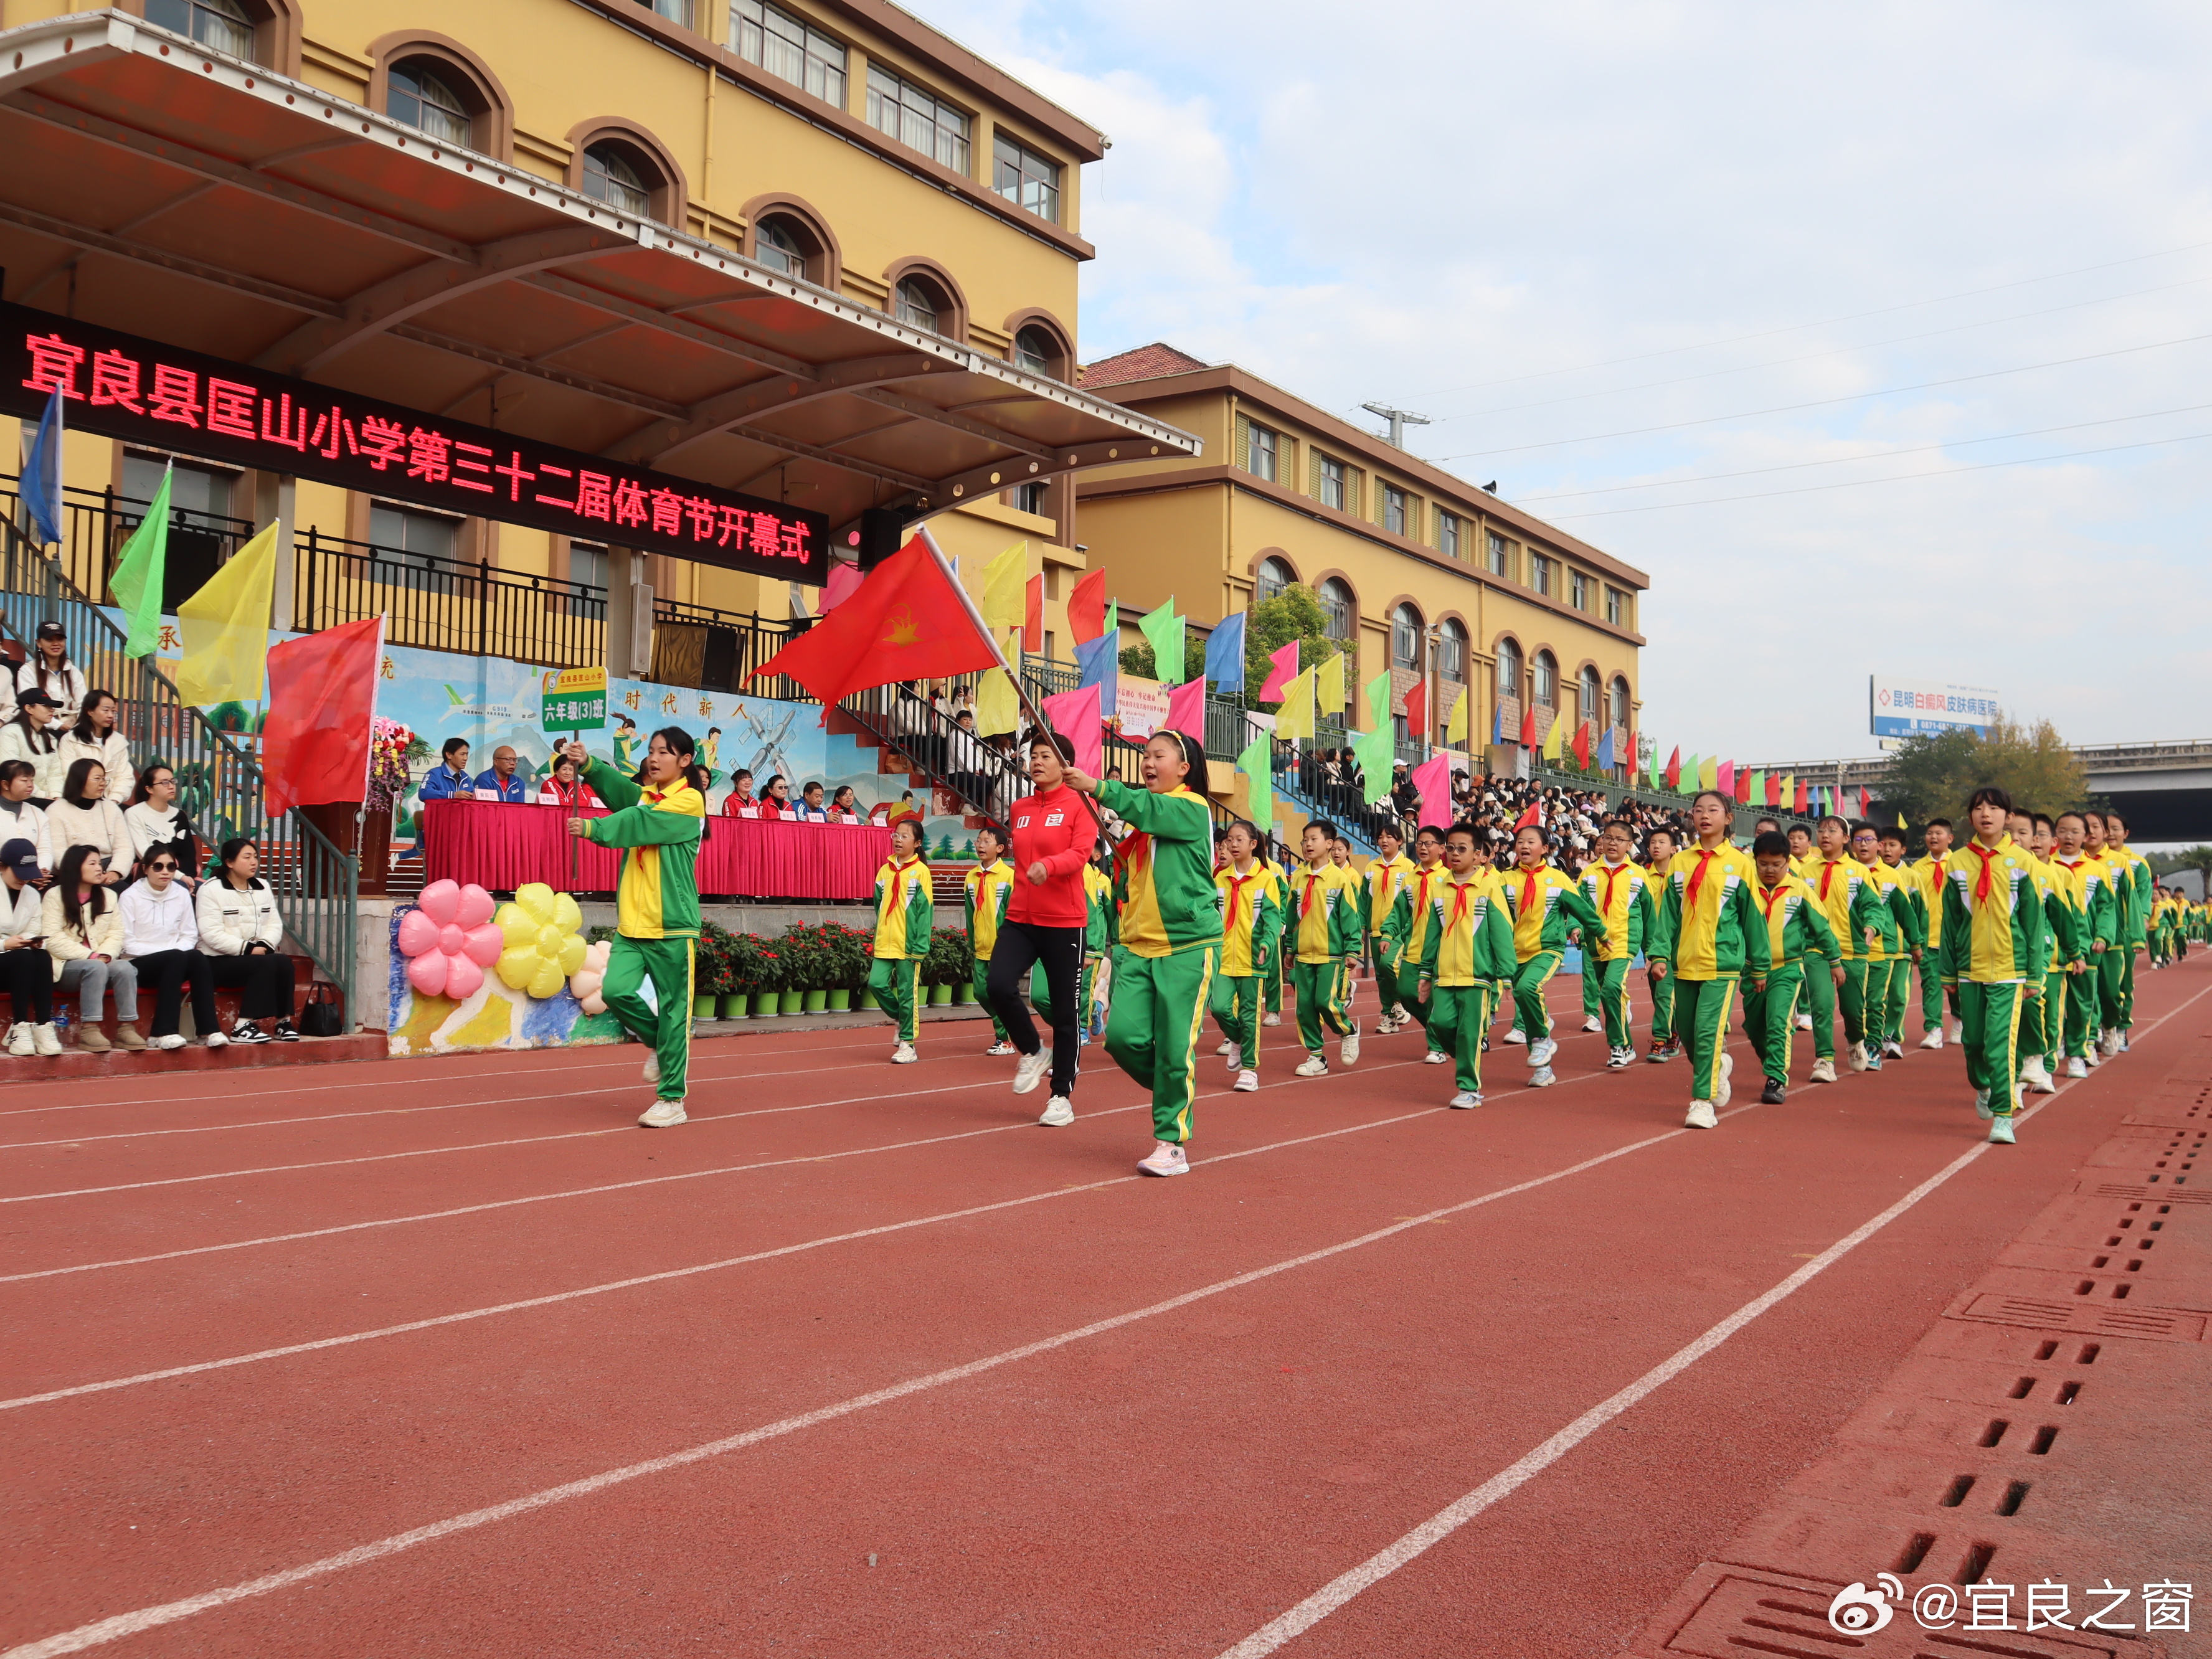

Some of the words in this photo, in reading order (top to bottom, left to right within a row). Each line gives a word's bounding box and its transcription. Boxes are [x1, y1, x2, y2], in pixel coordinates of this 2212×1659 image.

[22, 333, 811, 564] 宜良县匡山小学第三十二届体育节开幕式
[560, 673, 603, 683] 宜良县匡山小学
[625, 689, 749, 719] 时代新人
[1118, 688, 1134, 697] 不忘初心
[1138, 692, 1156, 702] 牢记使命
[1893, 690, 1997, 716] 昆明白癜风皮肤病医院
[544, 698, 604, 722] 六年级(3)班
[1016, 813, 1064, 829] 中国
